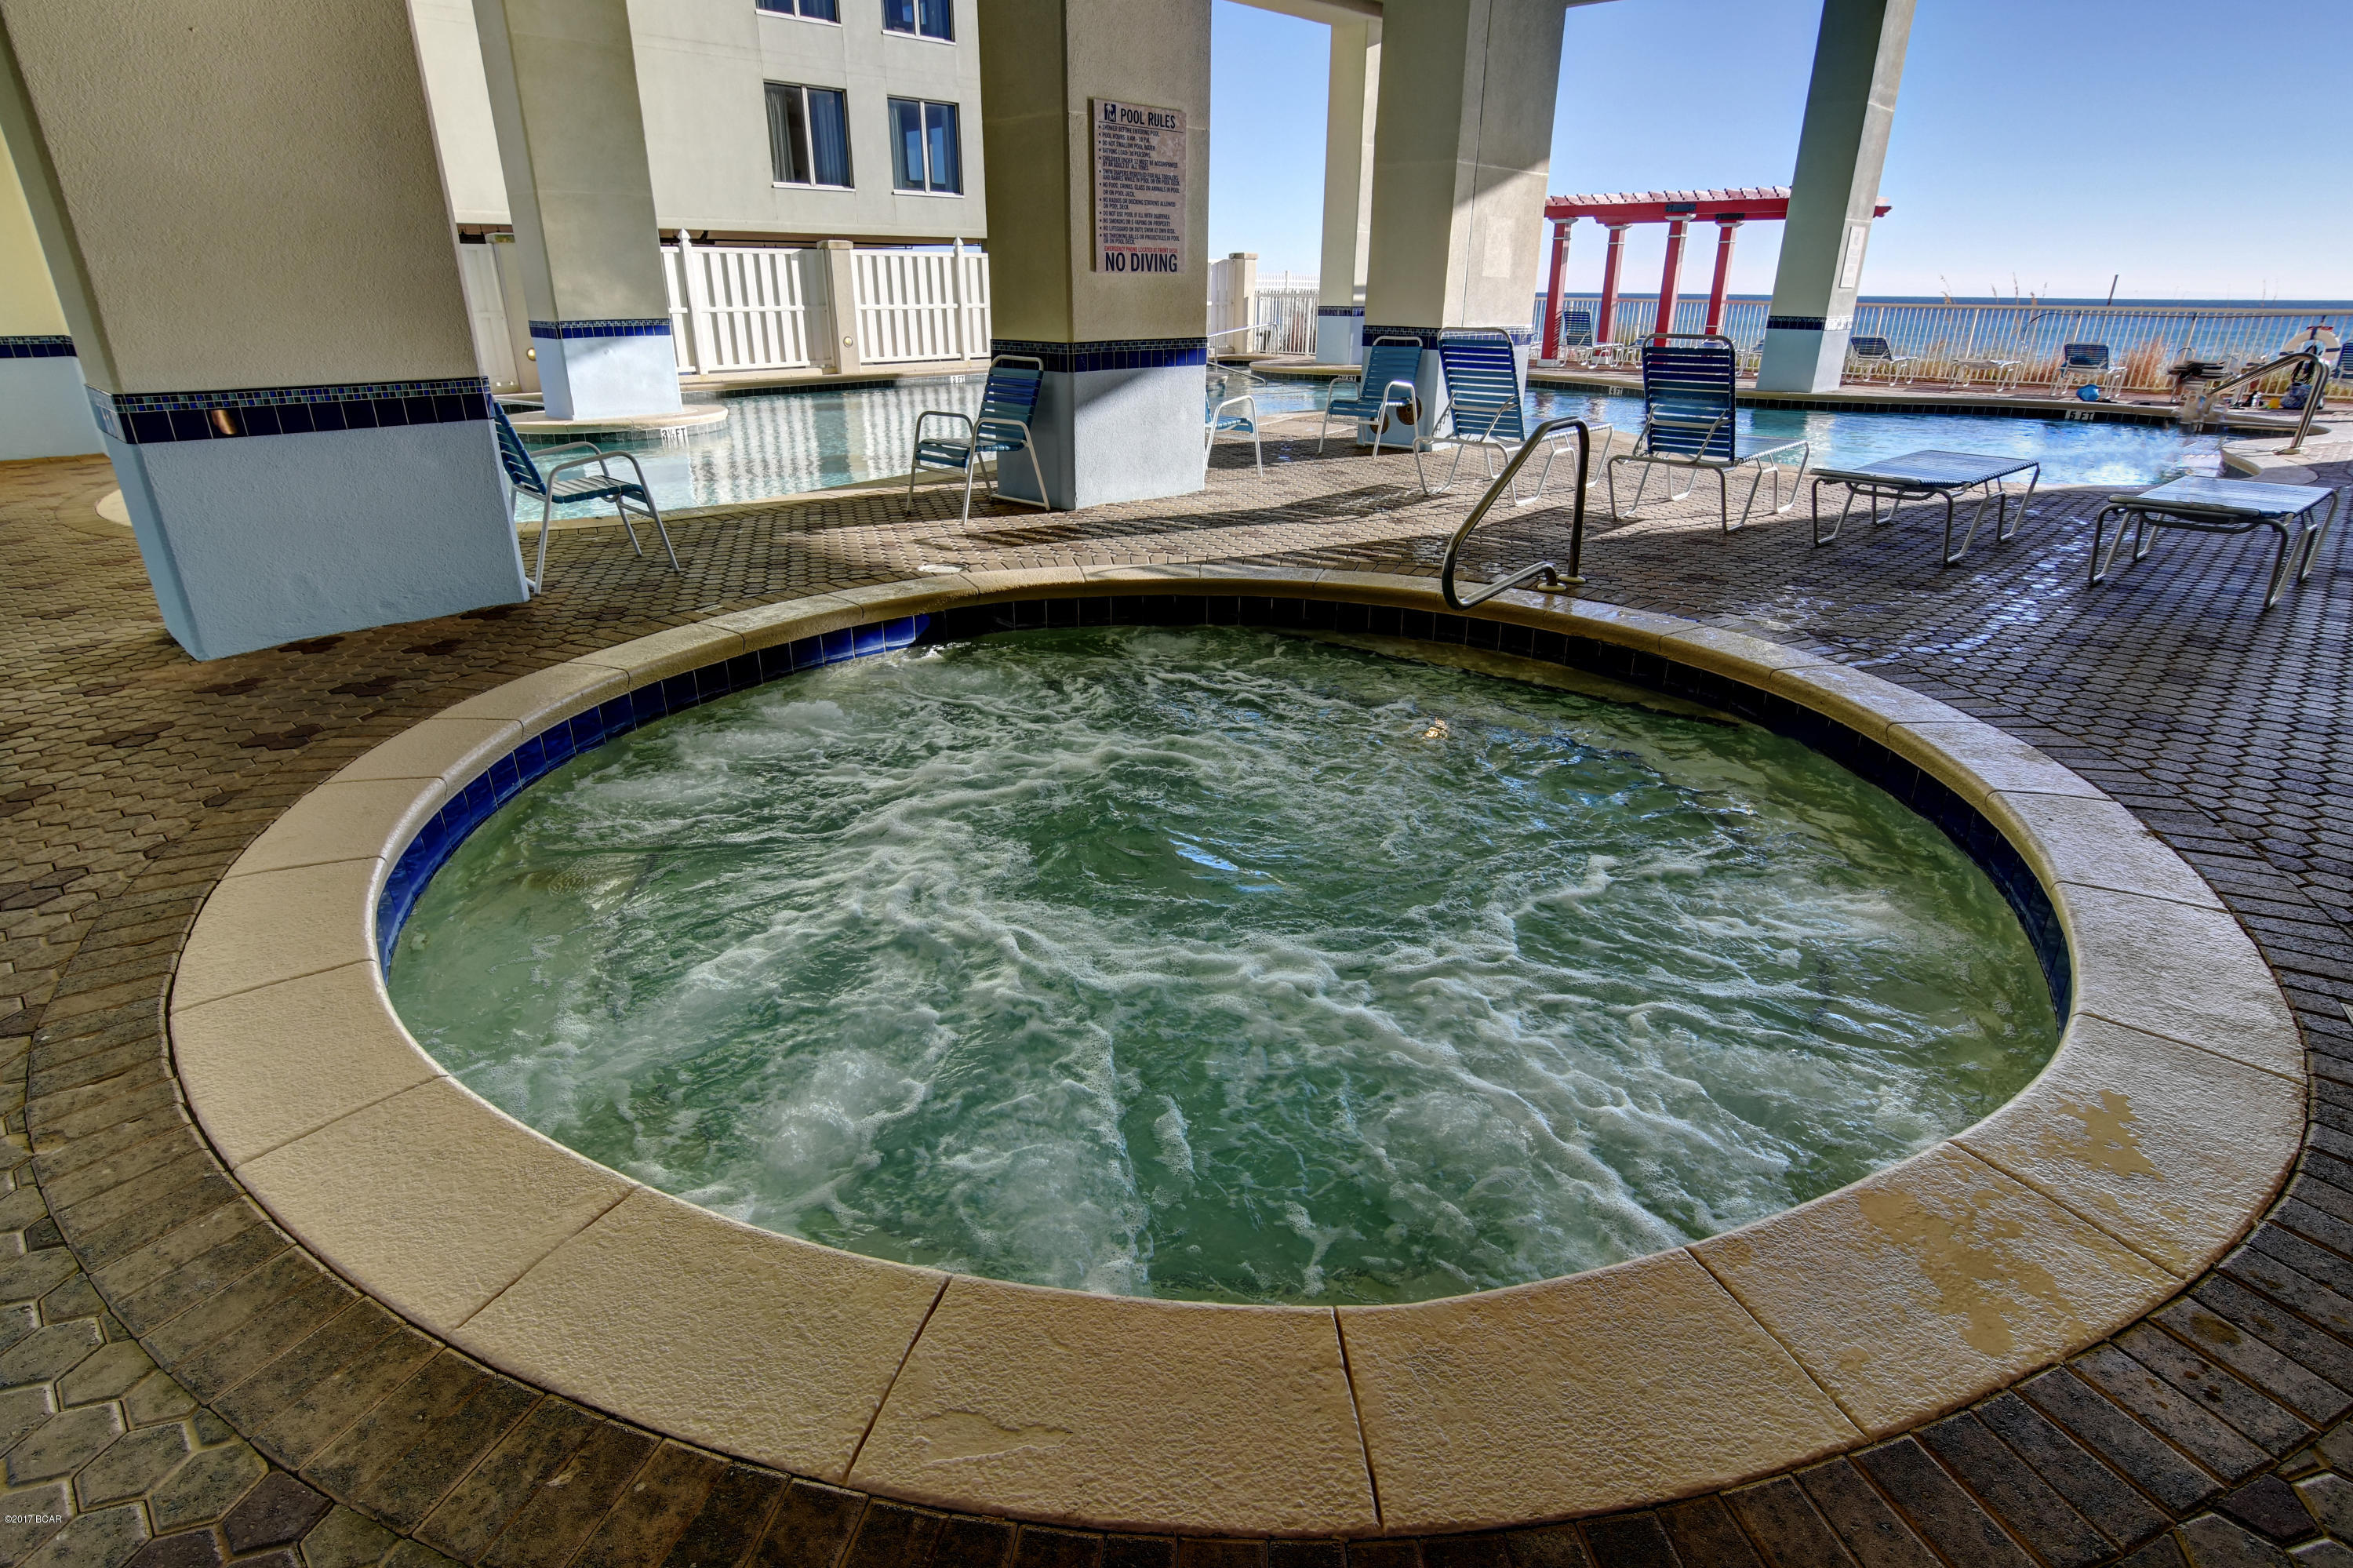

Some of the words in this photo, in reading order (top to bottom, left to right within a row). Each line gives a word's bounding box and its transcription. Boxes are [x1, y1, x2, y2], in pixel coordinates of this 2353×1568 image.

[1121, 108, 1144, 125] POOL
[1148, 112, 1176, 129] RULES
[1106, 252, 1126, 271] NO
[1131, 253, 1177, 272] DIVING
[2069, 411, 2077, 420] 5
[2080, 412, 2093, 421] FT
